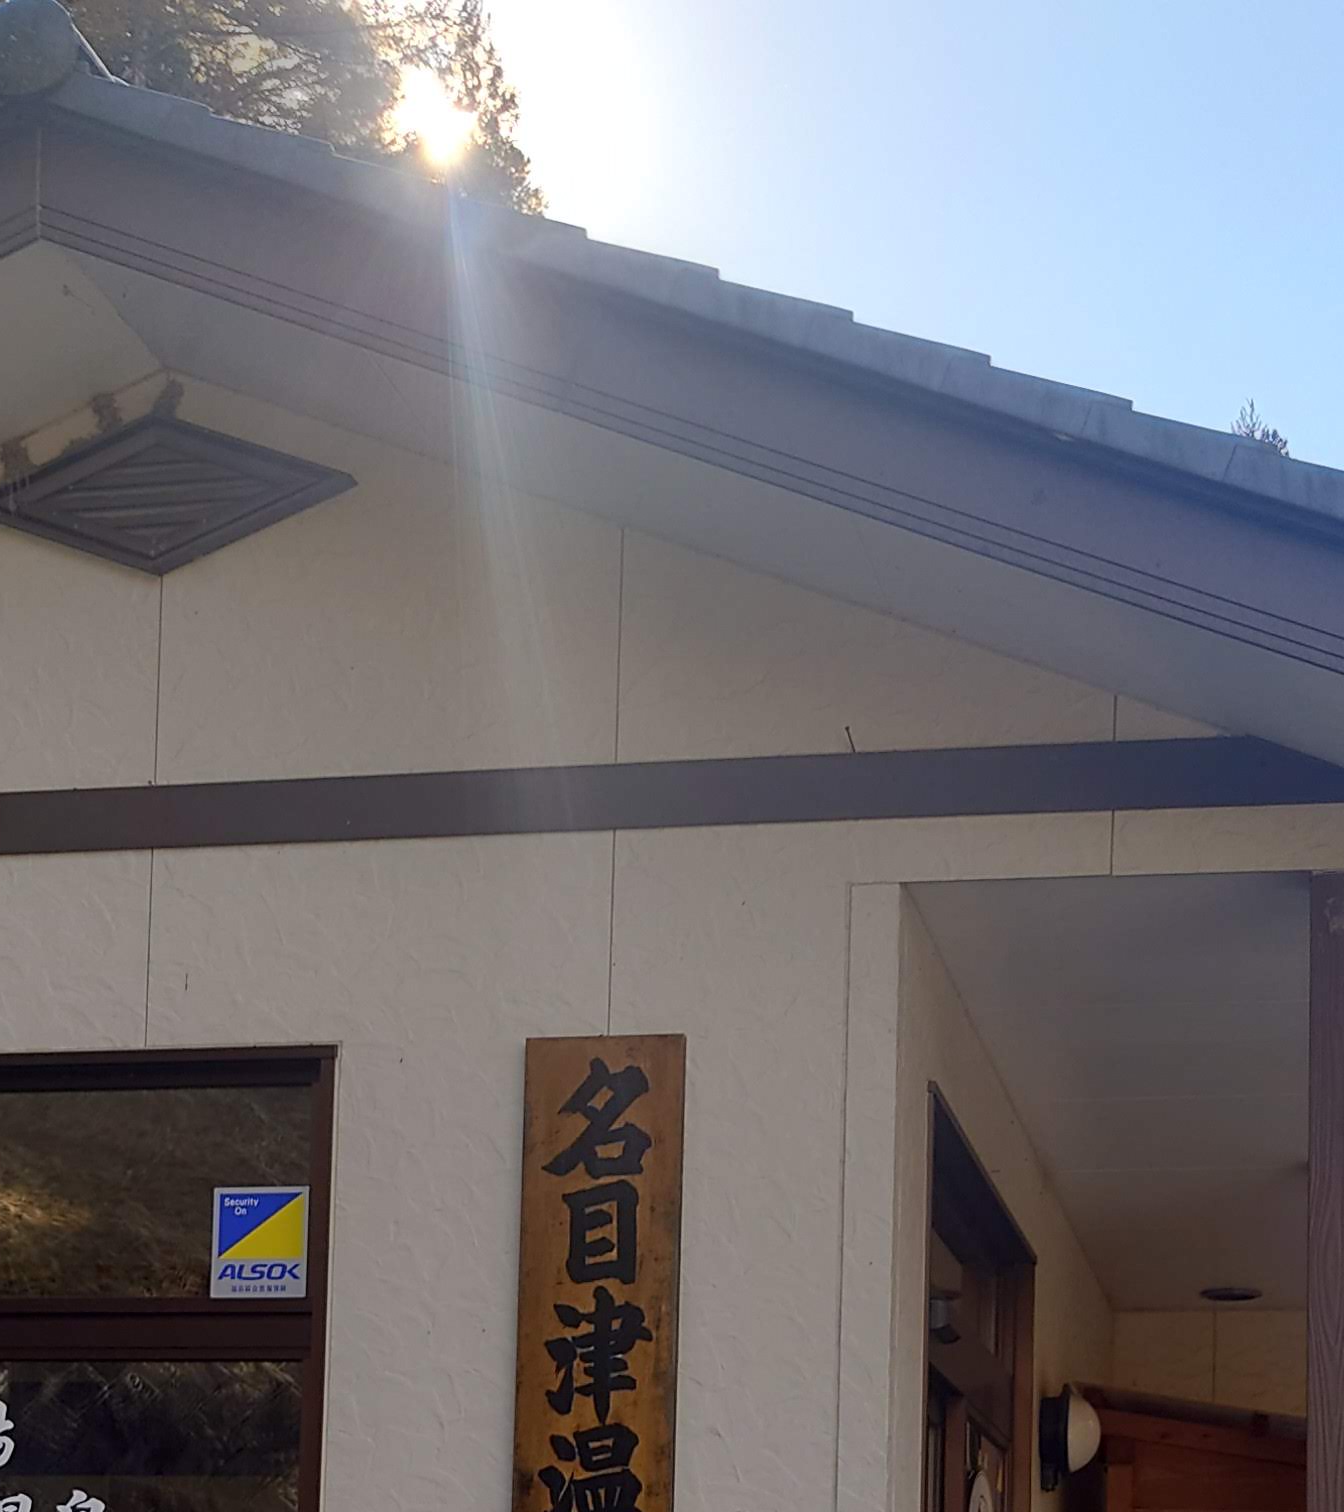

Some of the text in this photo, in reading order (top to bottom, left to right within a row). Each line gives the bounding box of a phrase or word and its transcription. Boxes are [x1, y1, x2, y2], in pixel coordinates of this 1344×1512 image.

[223, 1197, 259, 1208] Security
[234, 1207, 247, 1216] On
[217, 1263, 301, 1281] ALSOK
